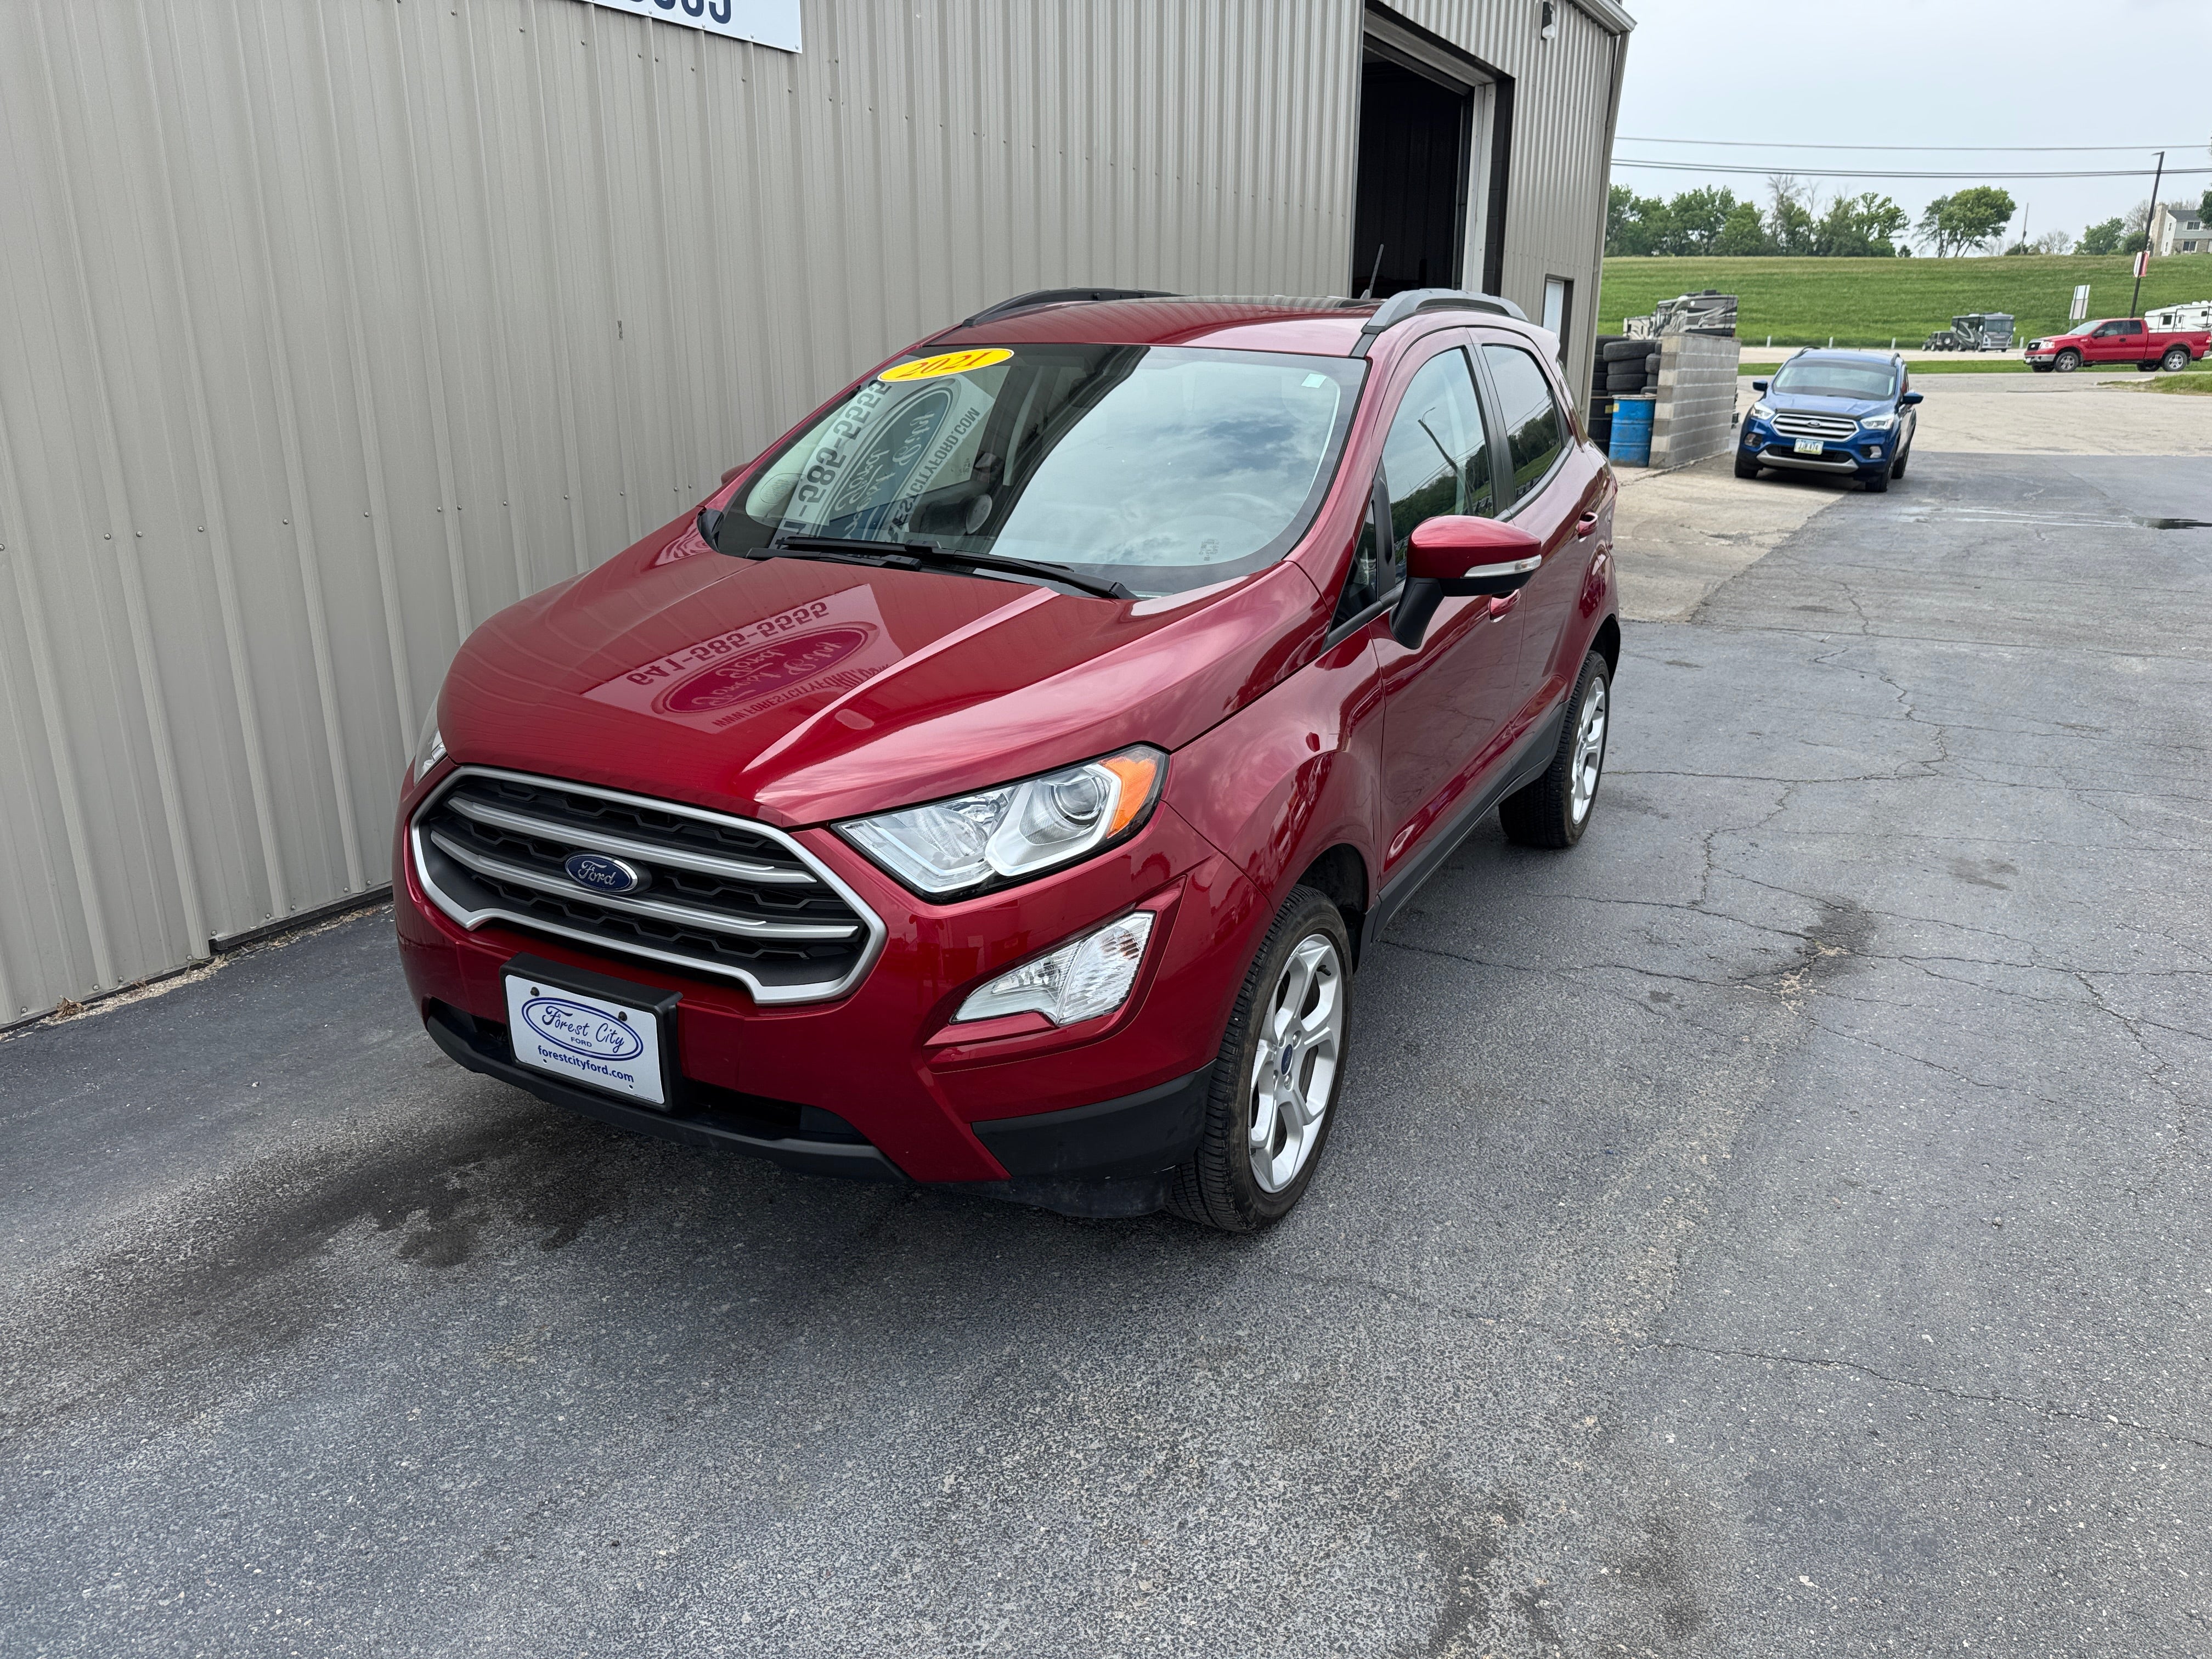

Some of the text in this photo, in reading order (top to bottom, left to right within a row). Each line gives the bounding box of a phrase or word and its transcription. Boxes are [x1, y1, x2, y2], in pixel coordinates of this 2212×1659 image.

[896, 351, 992, 379] 2021
[578, 860, 616, 885] Ford
[542, 1006, 625, 1053] Forest City
[571, 1036, 592, 1047] FORD
[538, 1045, 634, 1083] forestcityford.com
